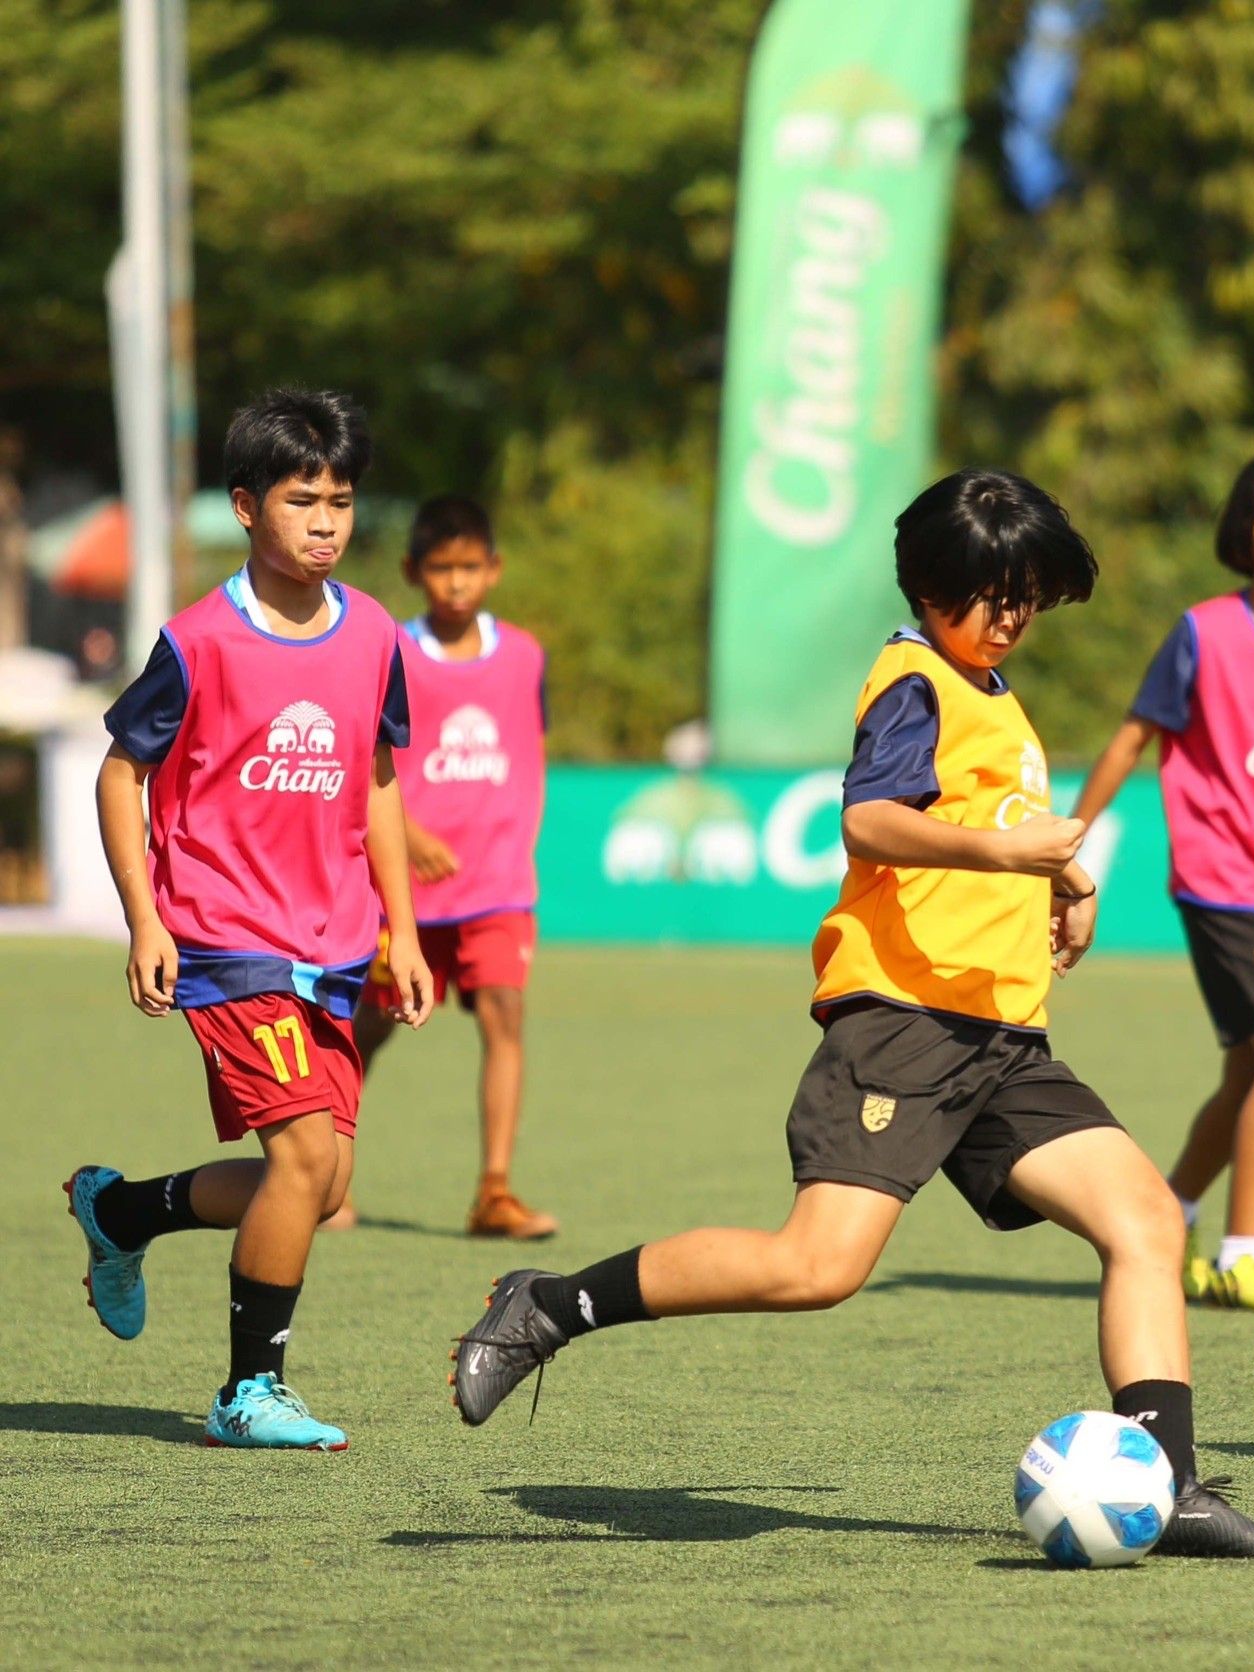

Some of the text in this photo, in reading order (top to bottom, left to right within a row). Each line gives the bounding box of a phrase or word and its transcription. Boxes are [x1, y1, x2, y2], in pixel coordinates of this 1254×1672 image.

[743, 186, 892, 546] Chang
[239, 755, 346, 800] Chang
[253, 1015, 310, 1084] 17
